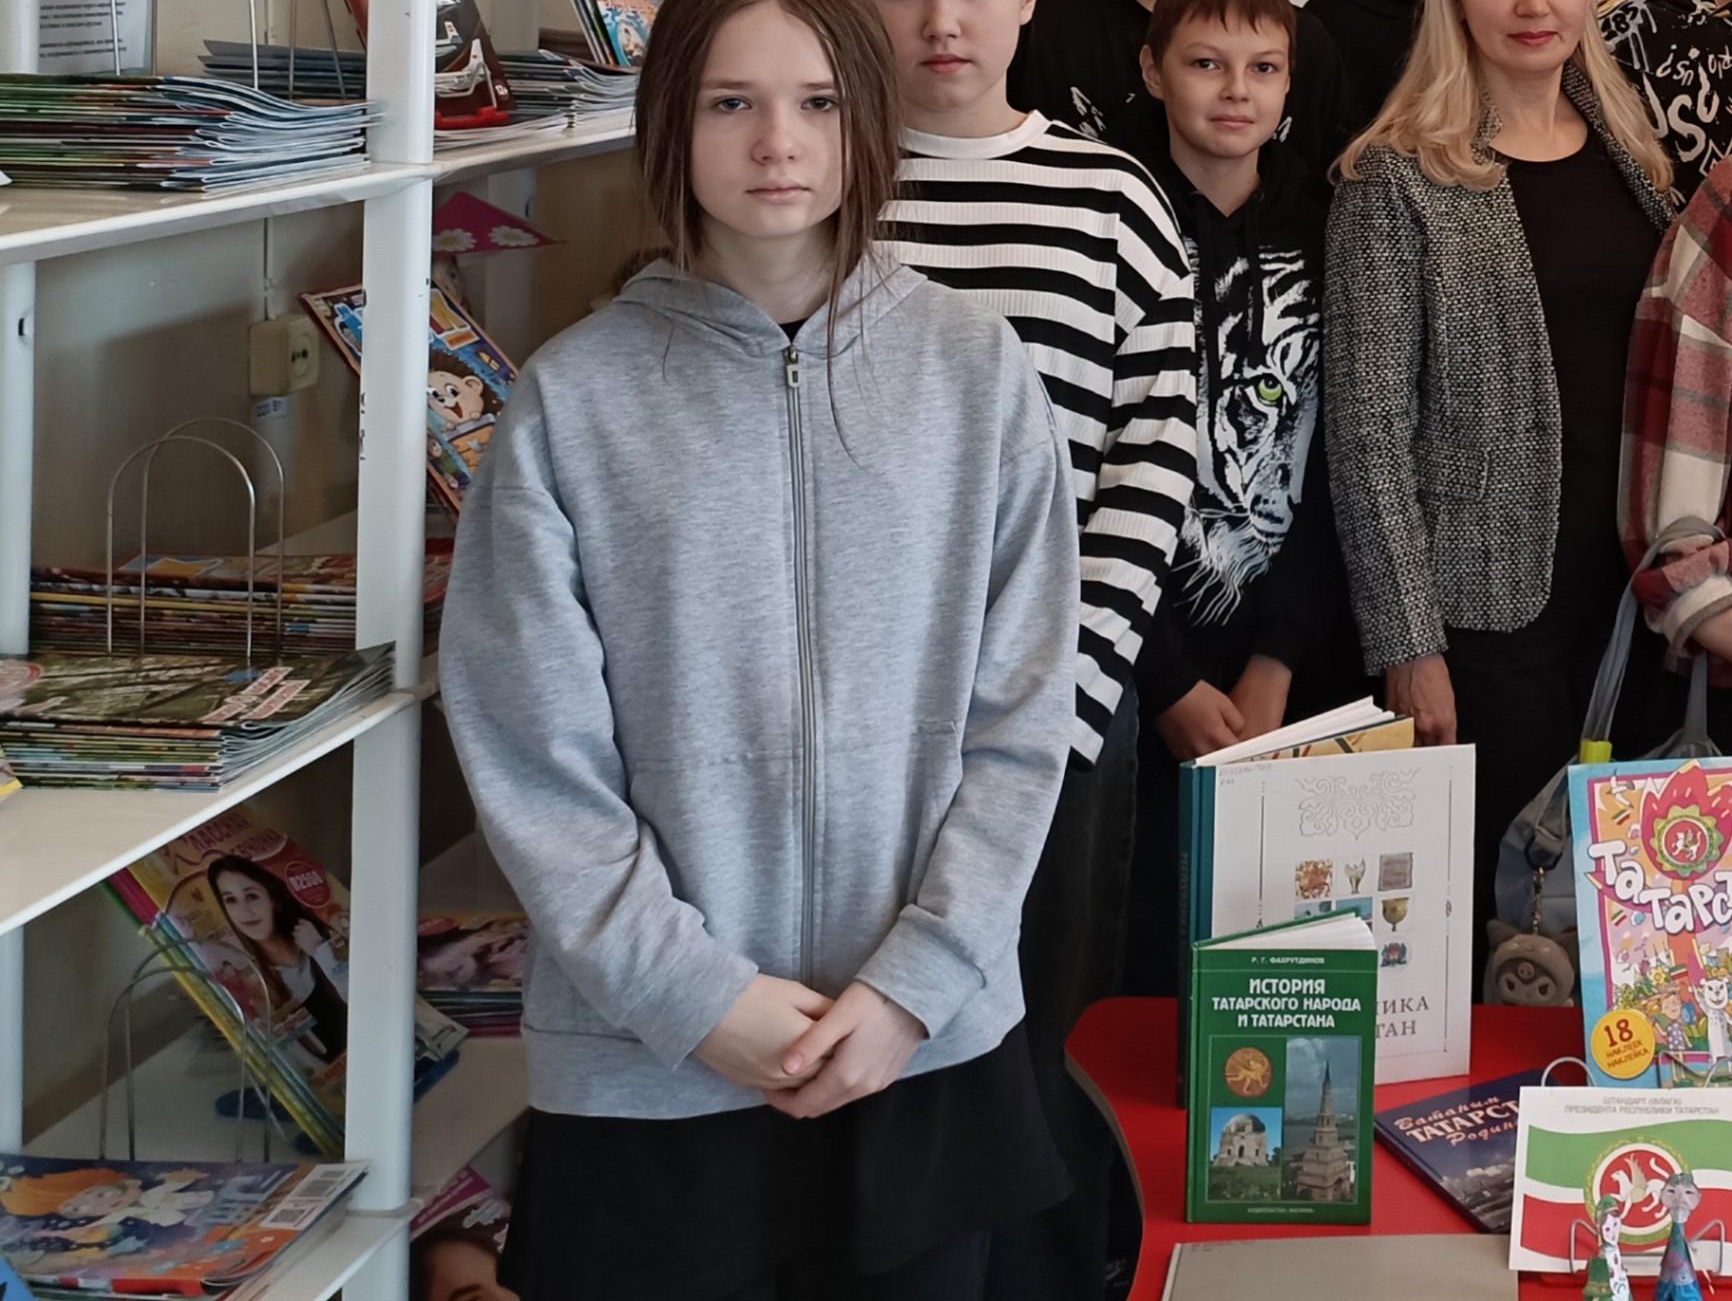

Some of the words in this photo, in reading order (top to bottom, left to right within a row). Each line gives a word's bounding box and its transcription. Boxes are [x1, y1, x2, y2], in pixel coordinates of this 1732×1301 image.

[1249, 978, 1325, 994] ИСТОРИЯ
[1212, 997, 1298, 1011] ТАТАРСКОГО
[1303, 997, 1361, 1011] НАРОДА
[1376, 996, 1430, 1016] ИКА
[1238, 1014, 1248, 1027] И
[1250, 1014, 1335, 1027] ТАТАРСТАНА
[1604, 1018, 1634, 1047] 18
[1674, 1106, 1720, 1115] ТАТАРСТАН
[1446, 1121, 1519, 1147] Родин
